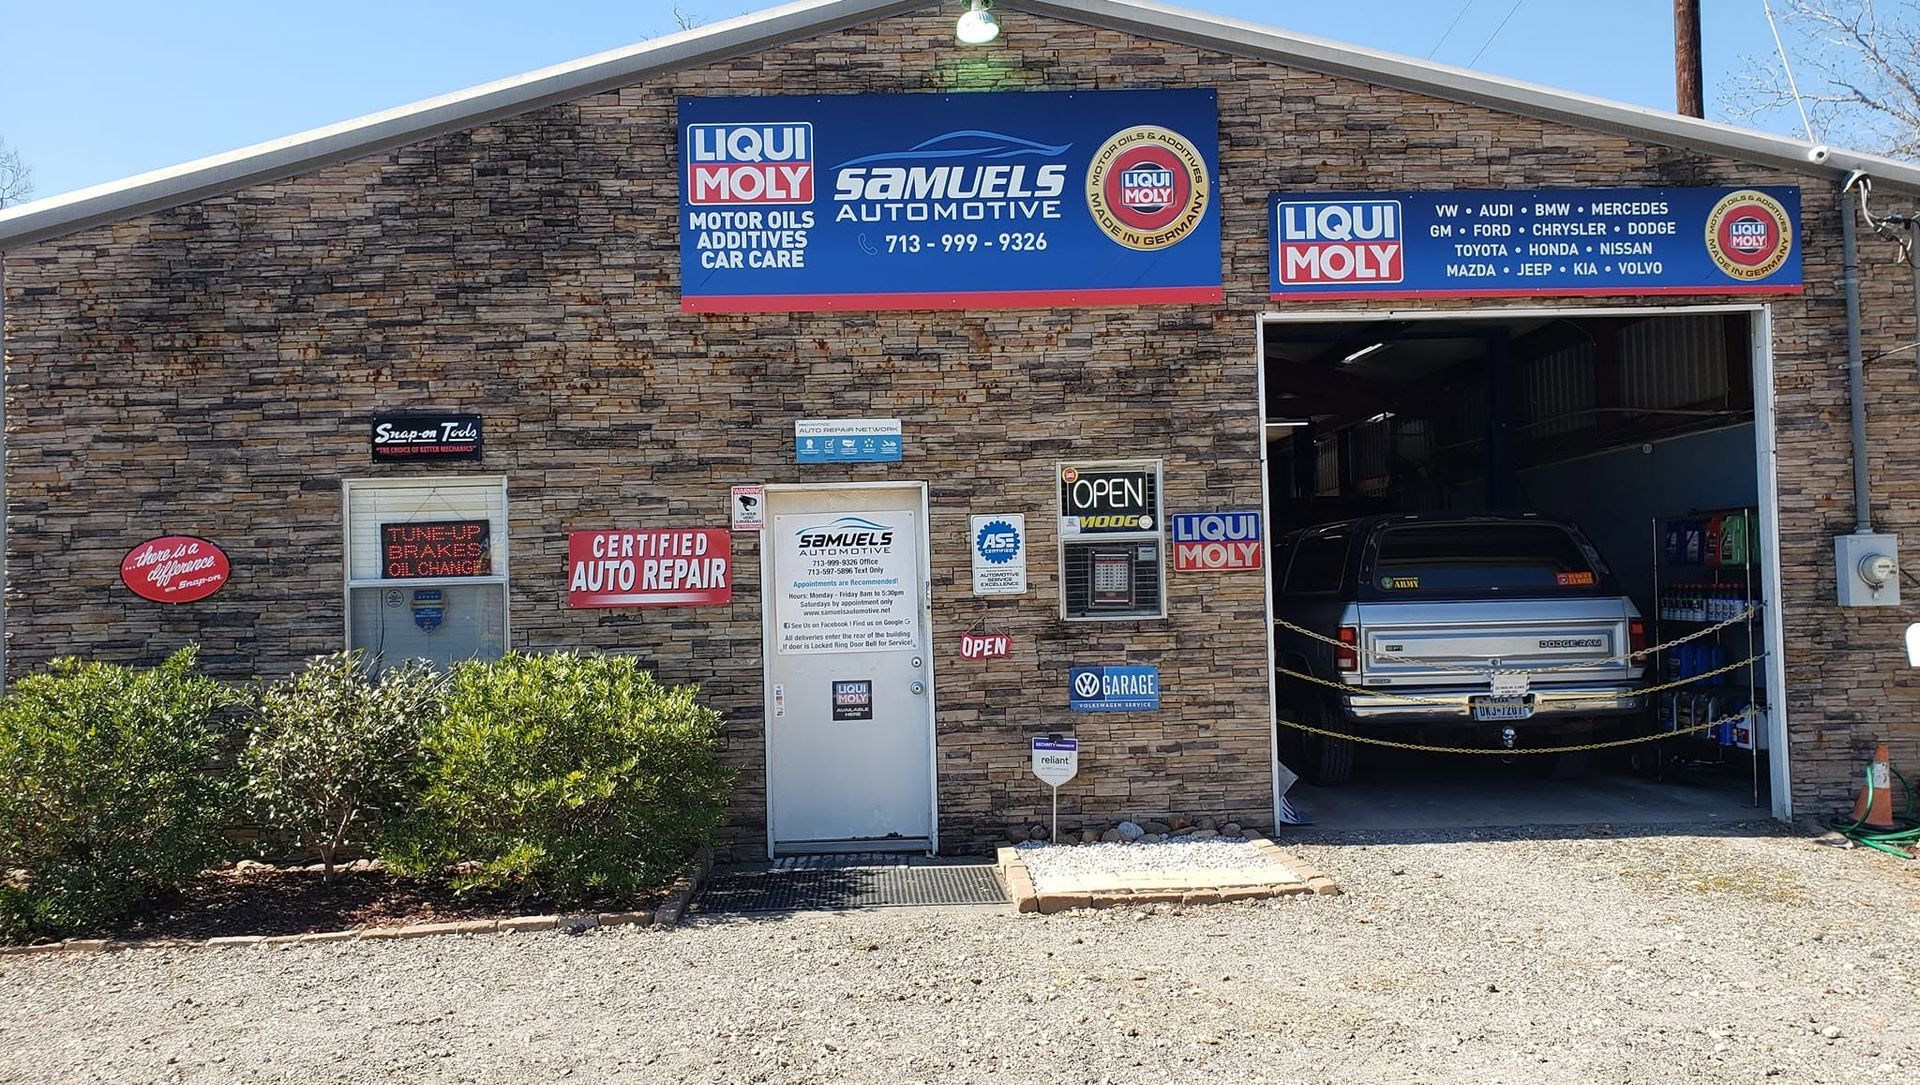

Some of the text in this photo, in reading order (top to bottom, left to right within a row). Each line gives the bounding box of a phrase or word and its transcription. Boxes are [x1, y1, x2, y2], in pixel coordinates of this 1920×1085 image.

[695, 127, 805, 163] LIQUI
[1092, 132, 1203, 186] MOTOR OILS & ADDITIVES
[696, 166, 810, 200] MOLY
[1125, 172, 1170, 188] LIQUI
[1125, 188, 1172, 203] MOLY
[835, 200, 1062, 222] AUTOMOTIVE
[1436, 202, 1669, 217] VW AUDI BMW MERCEDES
[1709, 203, 1728, 234] MOTOR
[1727, 195, 1746, 206] OILS
[1755, 196, 1788, 233] ADDITIVES
[689, 210, 815, 230] MOTOR OILS
[1091, 190, 1205, 246] MADE IN GERMANY
[1285, 205, 1394, 241] LIQUI
[1430, 221, 1676, 237] GM FORD CHRYSLER DODGE
[1732, 224, 1765, 236] LIQUI
[697, 231, 808, 249] ADDITIVES
[885, 234, 921, 253] 713
[941, 233, 978, 252] 999
[999, 232, 1048, 251] 9326
[1732, 235, 1766, 247] MOLY
[1454, 242, 1653, 257] TOYOTA HONDA NISSAN
[1708, 237, 1789, 277] MADE IN GERMANY
[701, 250, 805, 269] CAR CARE
[1286, 245, 1399, 280] MOLY
[1446, 261, 1663, 277] MAZDA JEEP KIA VOLVO
[374, 423, 437, 443] Snap-on
[1073, 478, 1143, 508] OPEN
[1079, 515, 1140, 528] MOOG
[1177, 515, 1256, 541] LIQUI
[388, 525, 480, 541] TUNE-UP
[982, 533, 1015, 549] ASE
[171, 543, 186, 559] is
[187, 543, 199, 554] a
[389, 543, 482, 559] BRAKES
[593, 533, 708, 558] CERTIFIED
[799, 547, 892, 556] AUTOMOTIVE
[812, 558, 879, 567] 713-999-9326 Office
[1178, 543, 1259, 568] MOLY
[389, 560, 482, 577] OIL CHANGE
[570, 558, 727, 592] AUTO REPAIR
[808, 566, 884, 575] 713-597-5896 Text Only
[793, 580, 837, 589] Appointments
[850, 578, 899, 586] Recommended!
[1394, 580, 1419, 588] ARMY
[800, 598, 893, 608] Saturdays by appointment only
[809, 591, 834, 600] Monday
[839, 590, 858, 599] Friday
[820, 620, 848, 628] Facebook
[853, 619, 866, 627] Find
[883, 618, 904, 627] Google
[794, 633, 824, 641] deliveries
[842, 632, 852, 640] the
[885, 630, 911, 639] building
[1539, 639, 1602, 648] DODGE RAM
[788, 642, 803, 650] door
[810, 641, 833, 649] Locked
[834, 641, 848, 649] Ring
[849, 640, 864, 648] Door
[865, 639, 877, 647] Bell
[878, 639, 887, 647] for
[962, 636, 1006, 658] OPEN
[838, 684, 866, 694] LIQUI
[1102, 674, 1155, 695] GARAGE
[838, 694, 868, 703] MOLY
[1041, 756, 1069, 765] reliant
